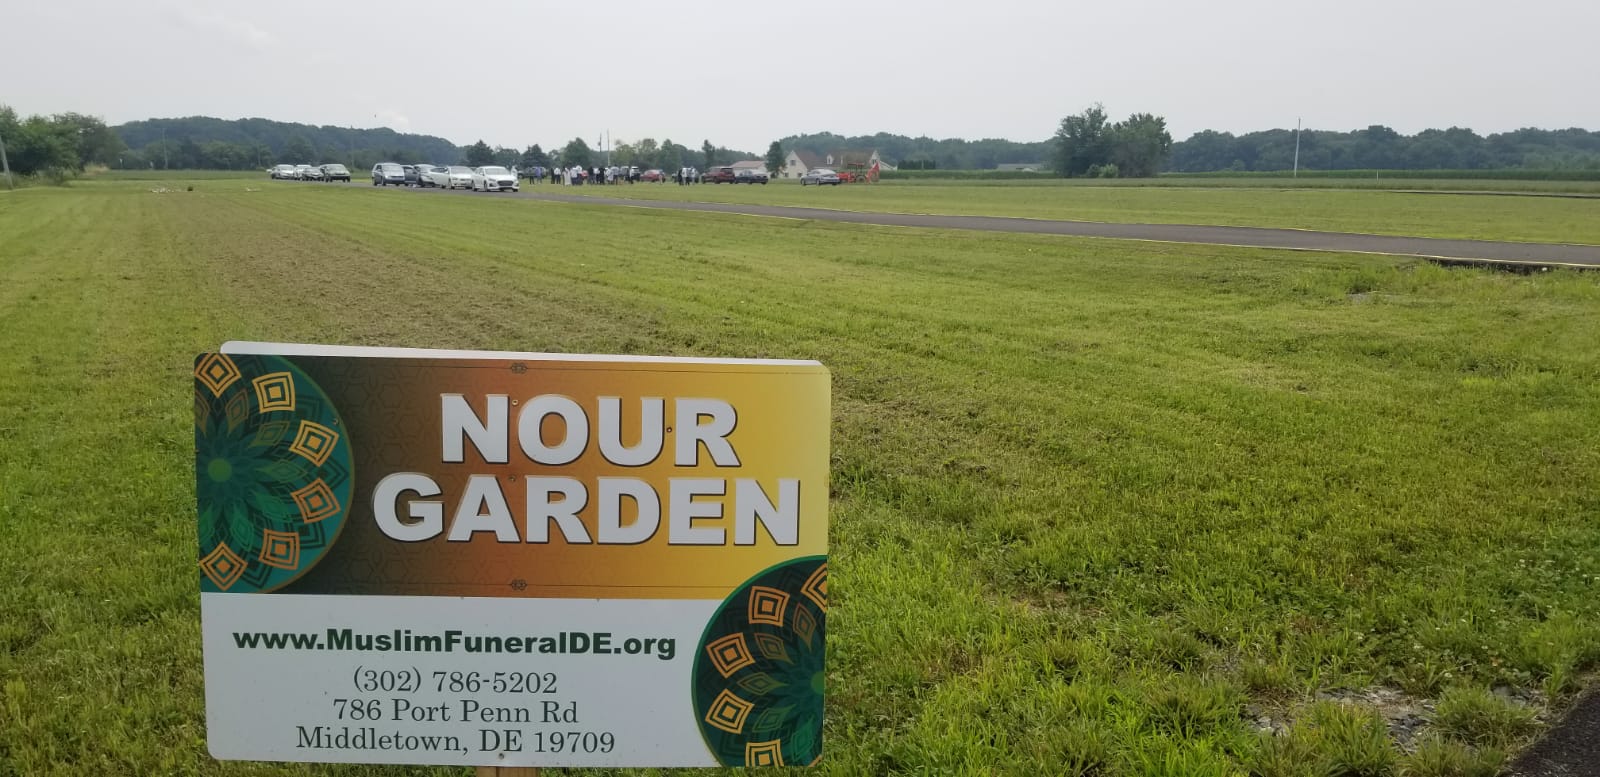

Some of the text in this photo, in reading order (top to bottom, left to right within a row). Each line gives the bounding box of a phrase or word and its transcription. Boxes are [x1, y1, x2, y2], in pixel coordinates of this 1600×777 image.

[440, 393, 741, 467] NOUR
[372, 472, 800, 545] GARDEN
[232, 628, 676, 660] www.MuslimFuneralDE.org
[352, 666, 558, 694] (302) 786-5202
[332, 698, 579, 724] 786 Port Penn Rd
[295, 726, 616, 755] Middletown, DE 19709
